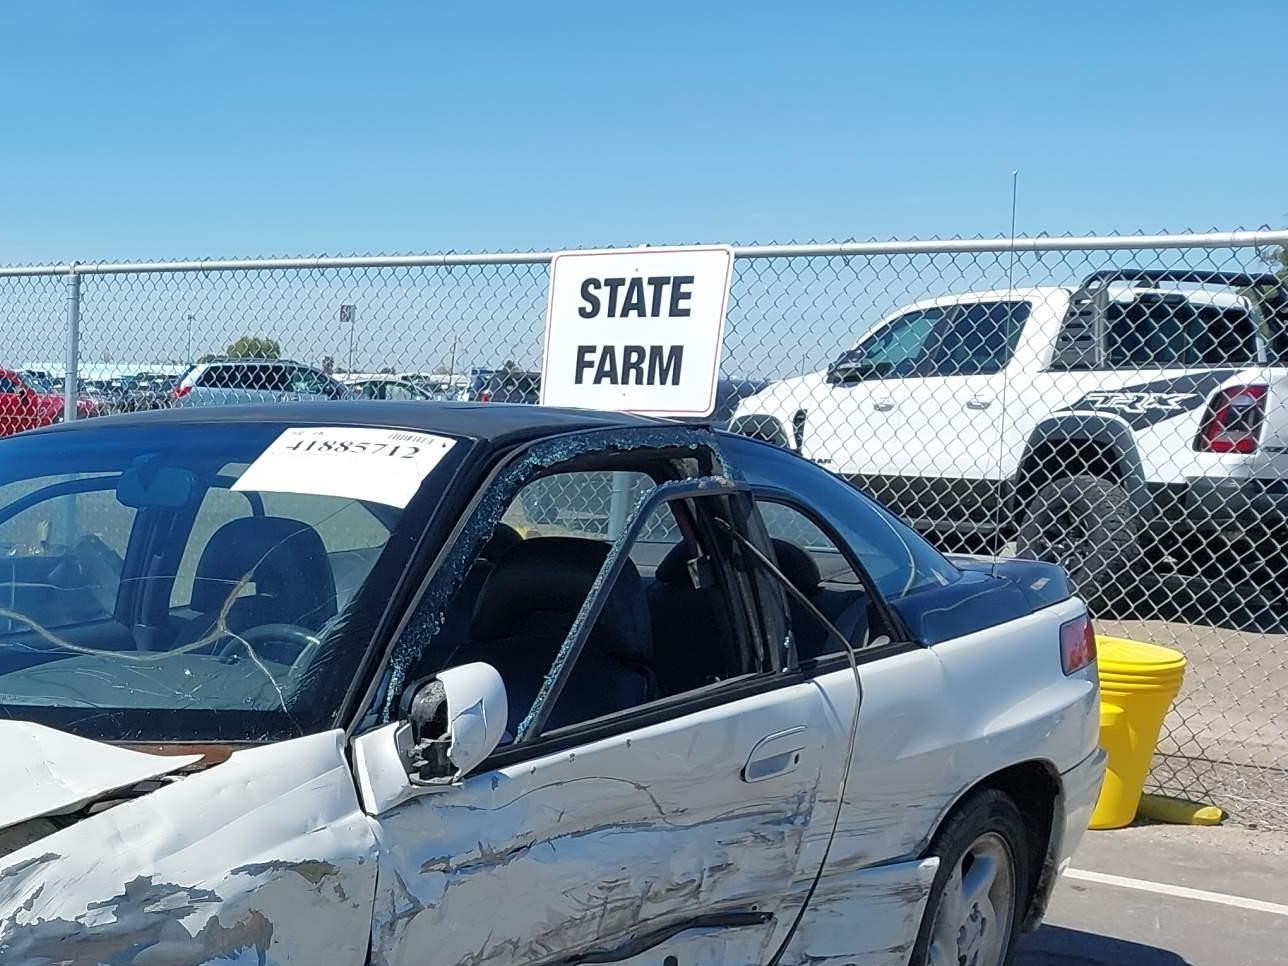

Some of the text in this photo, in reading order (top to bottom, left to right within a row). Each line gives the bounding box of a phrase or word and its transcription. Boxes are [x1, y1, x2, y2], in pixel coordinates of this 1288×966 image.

[578, 275, 695, 319] STATE
[574, 345, 685, 386] FARM
[286, 439, 421, 459] 41885712
